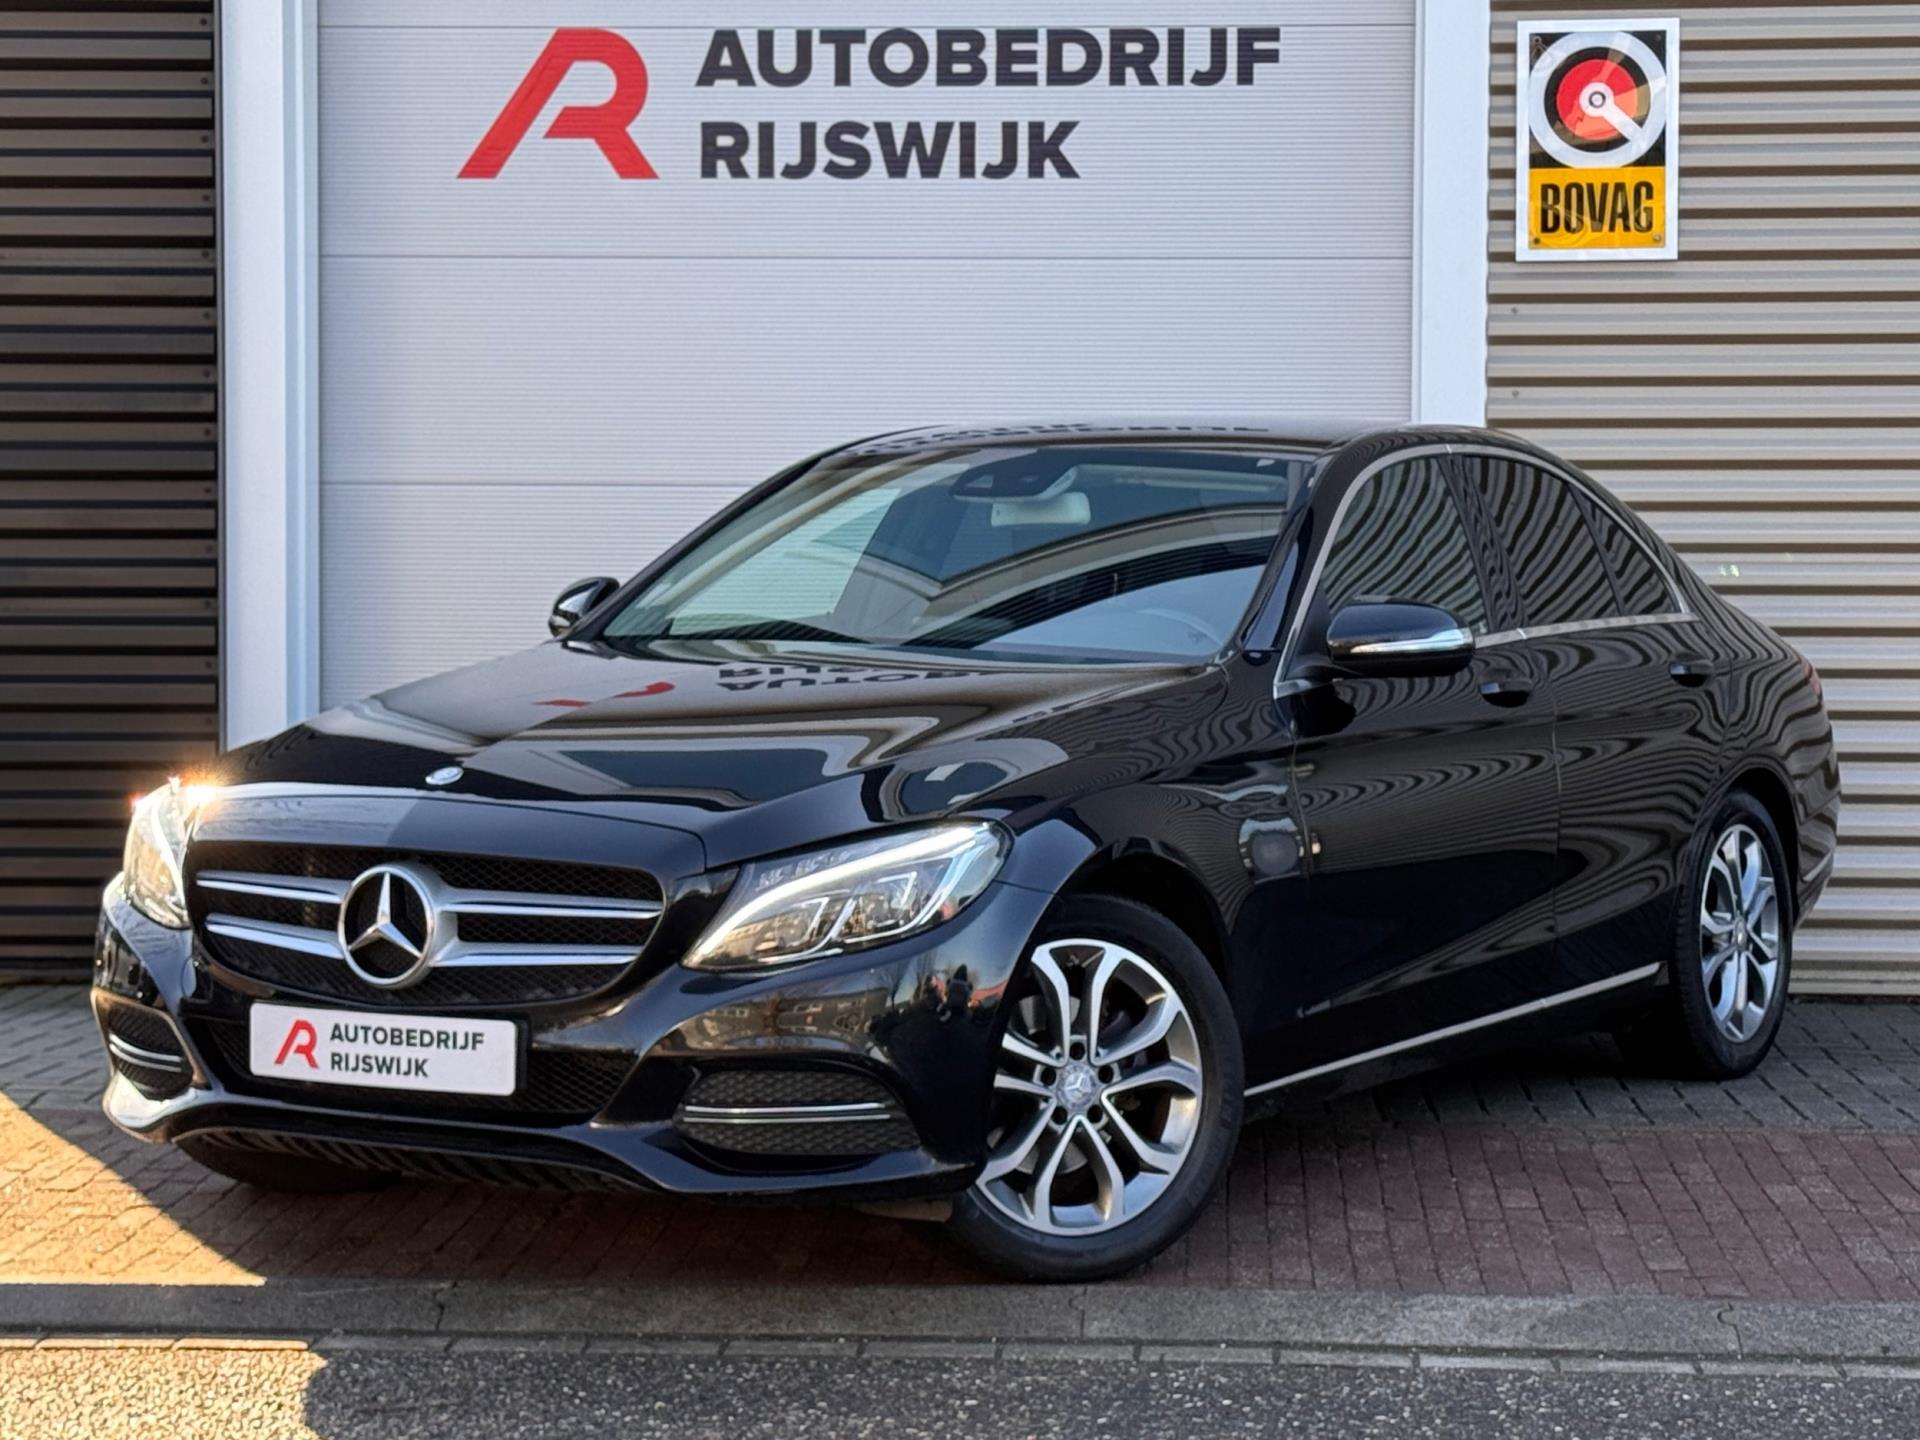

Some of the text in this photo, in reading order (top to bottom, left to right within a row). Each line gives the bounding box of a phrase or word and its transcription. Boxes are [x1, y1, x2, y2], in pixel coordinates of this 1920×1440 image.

[696, 27, 1281, 88] AUTOBEDRIJF
[700, 120, 1081, 180] RIJSWIJK
[1539, 181, 1654, 234] BOVAG
[330, 1023, 485, 1051] AUTOBEDRIJF
[331, 1052, 429, 1078] RIJSWIJK
